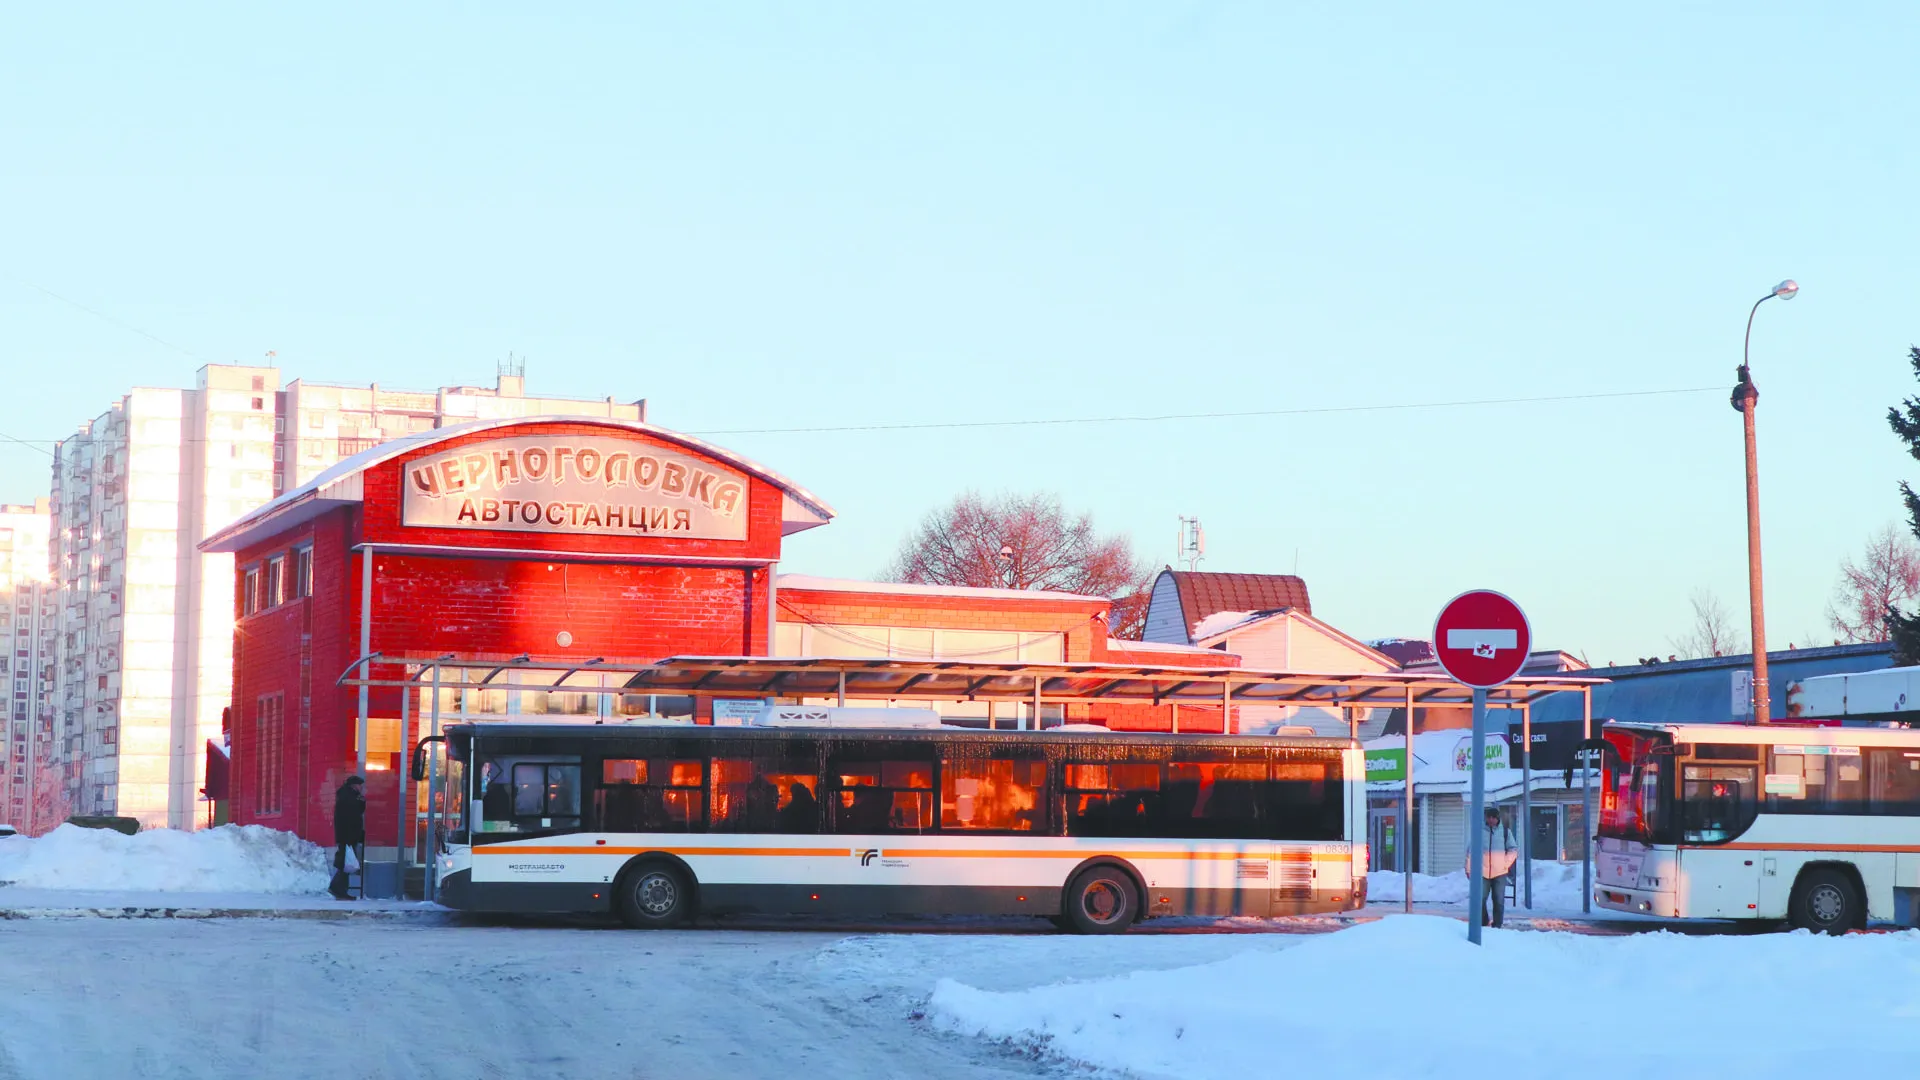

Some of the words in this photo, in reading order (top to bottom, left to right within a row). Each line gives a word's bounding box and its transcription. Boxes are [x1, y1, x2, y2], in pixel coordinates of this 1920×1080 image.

[410, 447, 743, 517] ЧЕРНОГОЛОВКА
[457, 499, 691, 532] АВТОСТАНЦИЯ
[1325, 844, 1349, 853] 0830
